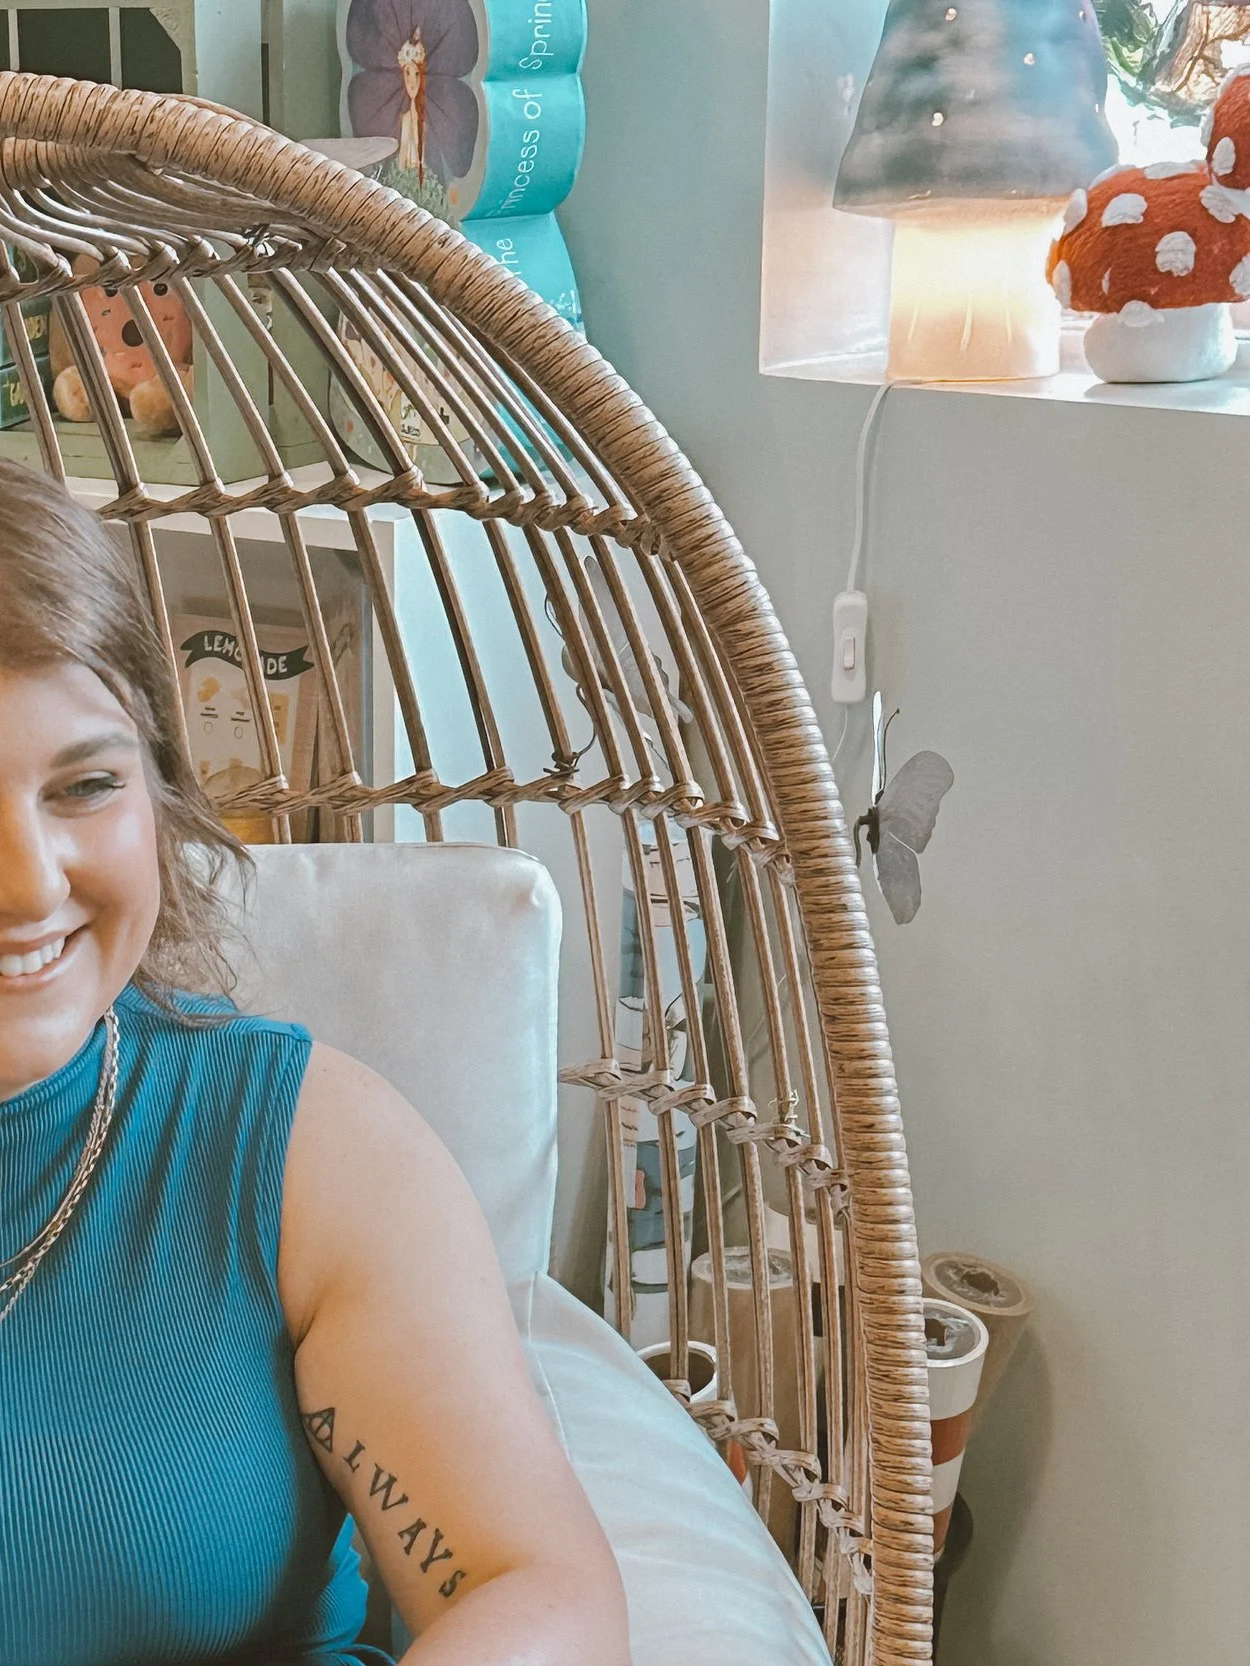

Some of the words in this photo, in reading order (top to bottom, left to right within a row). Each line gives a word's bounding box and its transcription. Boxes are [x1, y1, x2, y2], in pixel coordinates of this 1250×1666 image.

[519, 0, 554, 69] Sprin
[512, 87, 543, 120] of
[486, 129, 540, 217] rincess
[496, 238, 522, 275] he
[203, 635, 288, 675] LEMODE
[301, 1407, 467, 1598] ALWAYS
